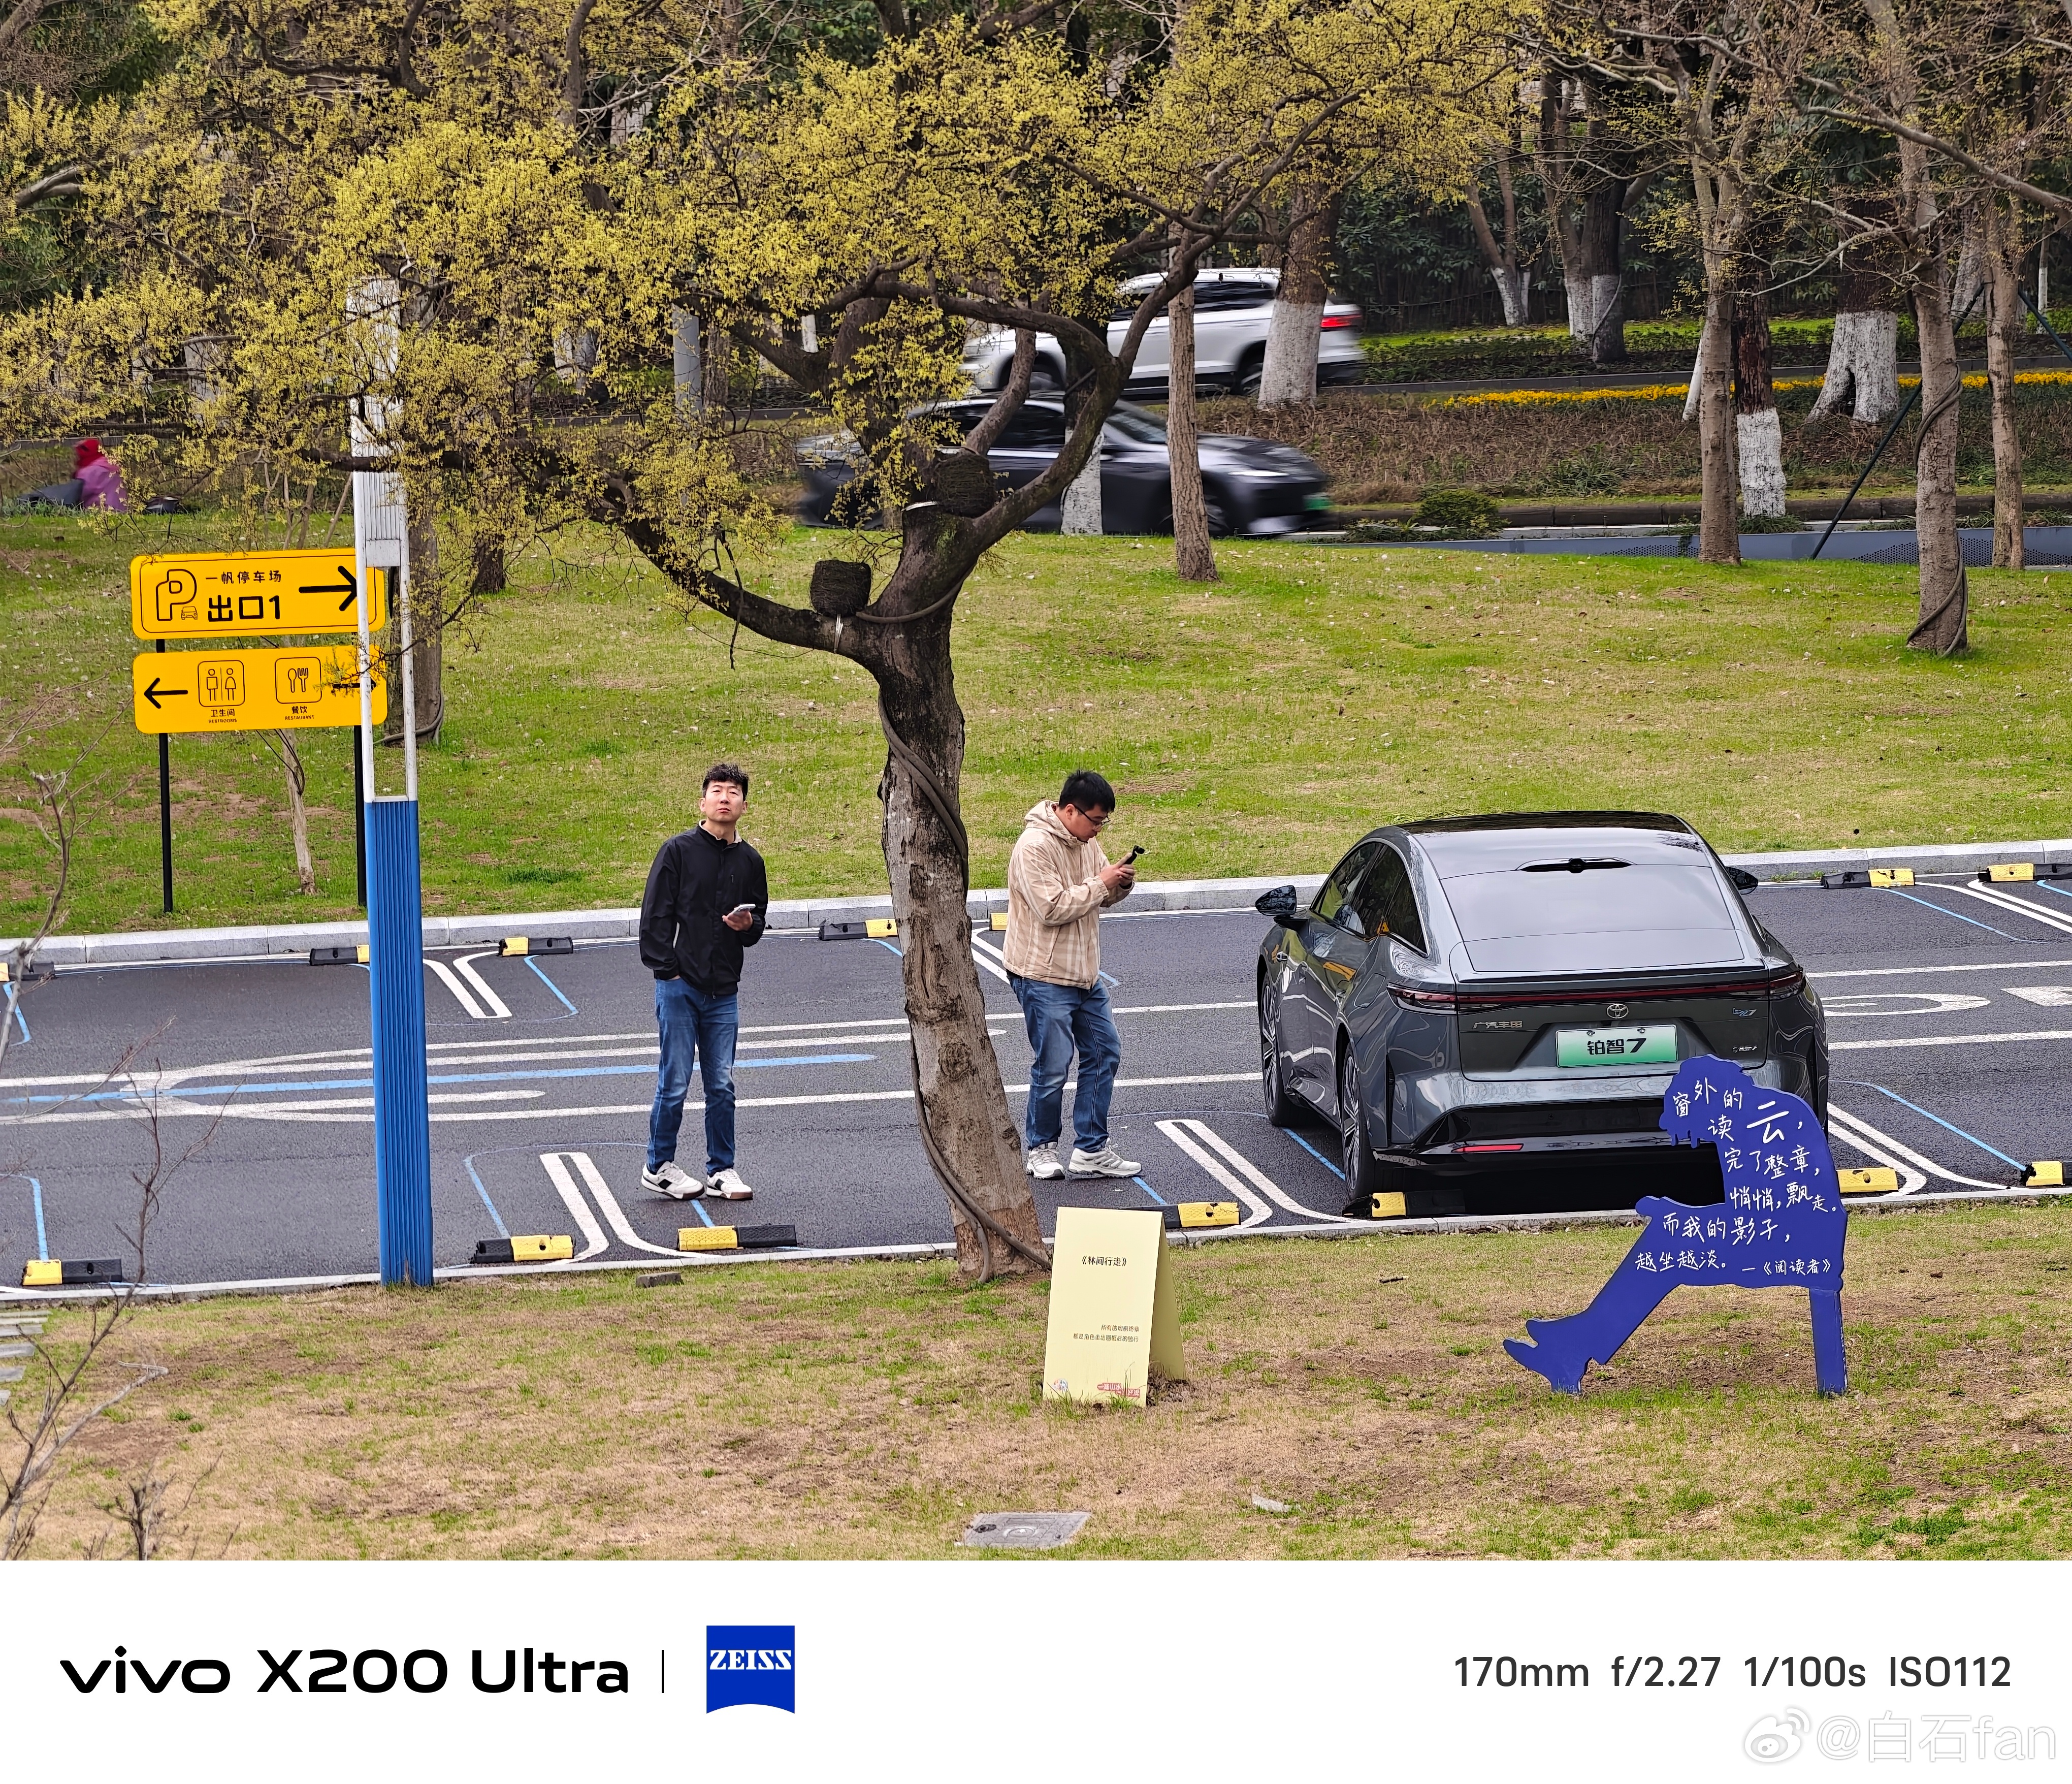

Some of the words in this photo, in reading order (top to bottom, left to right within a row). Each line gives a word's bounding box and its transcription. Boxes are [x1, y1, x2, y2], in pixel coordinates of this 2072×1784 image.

[205, 570, 281, 585] 一帆停车场
[208, 594, 280, 622] 出口1
[211, 709, 235, 717] 卫生间
[292, 706, 308, 714] 餐饮
[1587, 1038, 1646, 1055] 铂智7
[1663, 1212, 1790, 1246] 而我的影子，
[1082, 1255, 1127, 1267] 《林间行走》
[1635, 1249, 1726, 1272] 越坐越淡。
